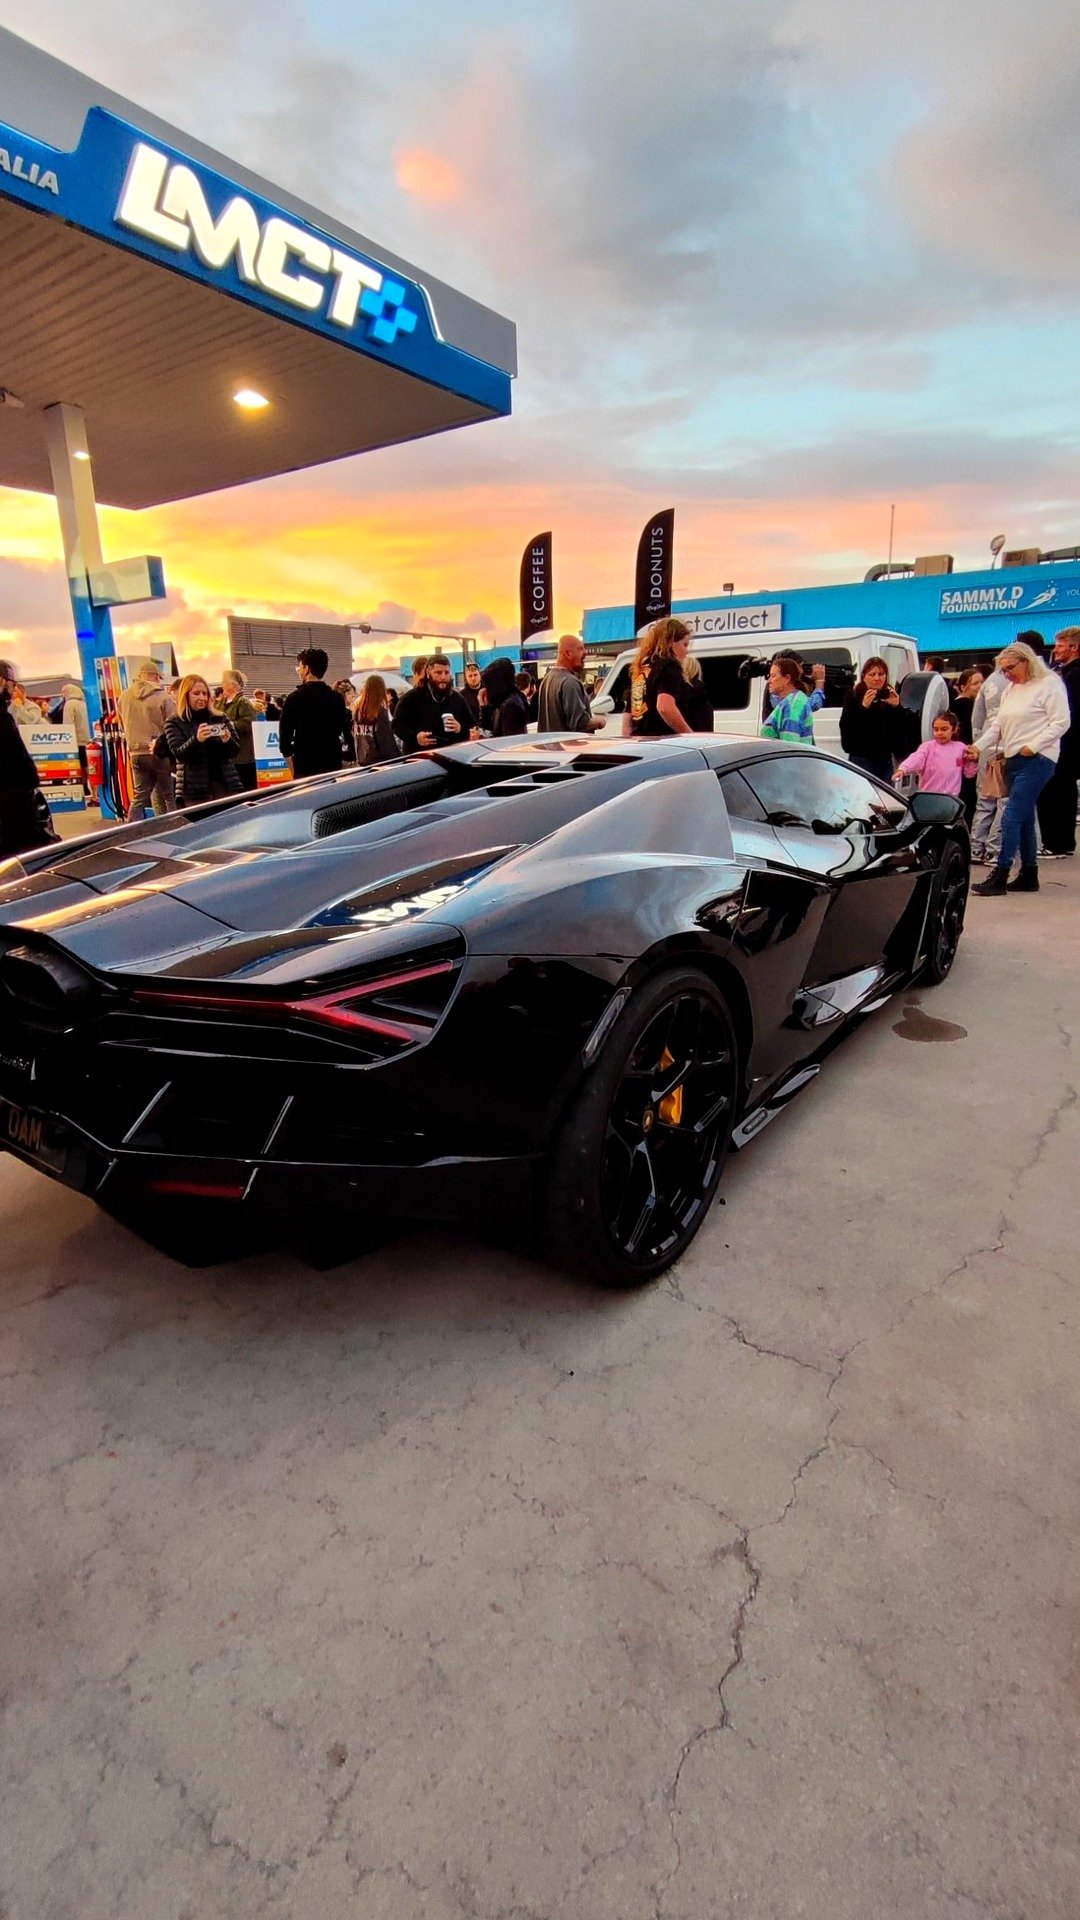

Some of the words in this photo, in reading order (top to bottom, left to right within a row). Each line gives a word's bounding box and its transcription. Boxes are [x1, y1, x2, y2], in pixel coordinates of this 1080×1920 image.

[532, 547, 544, 611] COFFEE
[651, 527, 663, 598] DONUTS
[941, 600, 1018, 613] FOUNDATION
[942, 587, 1007, 605] SAMMY
[1012, 586, 1024, 599] D
